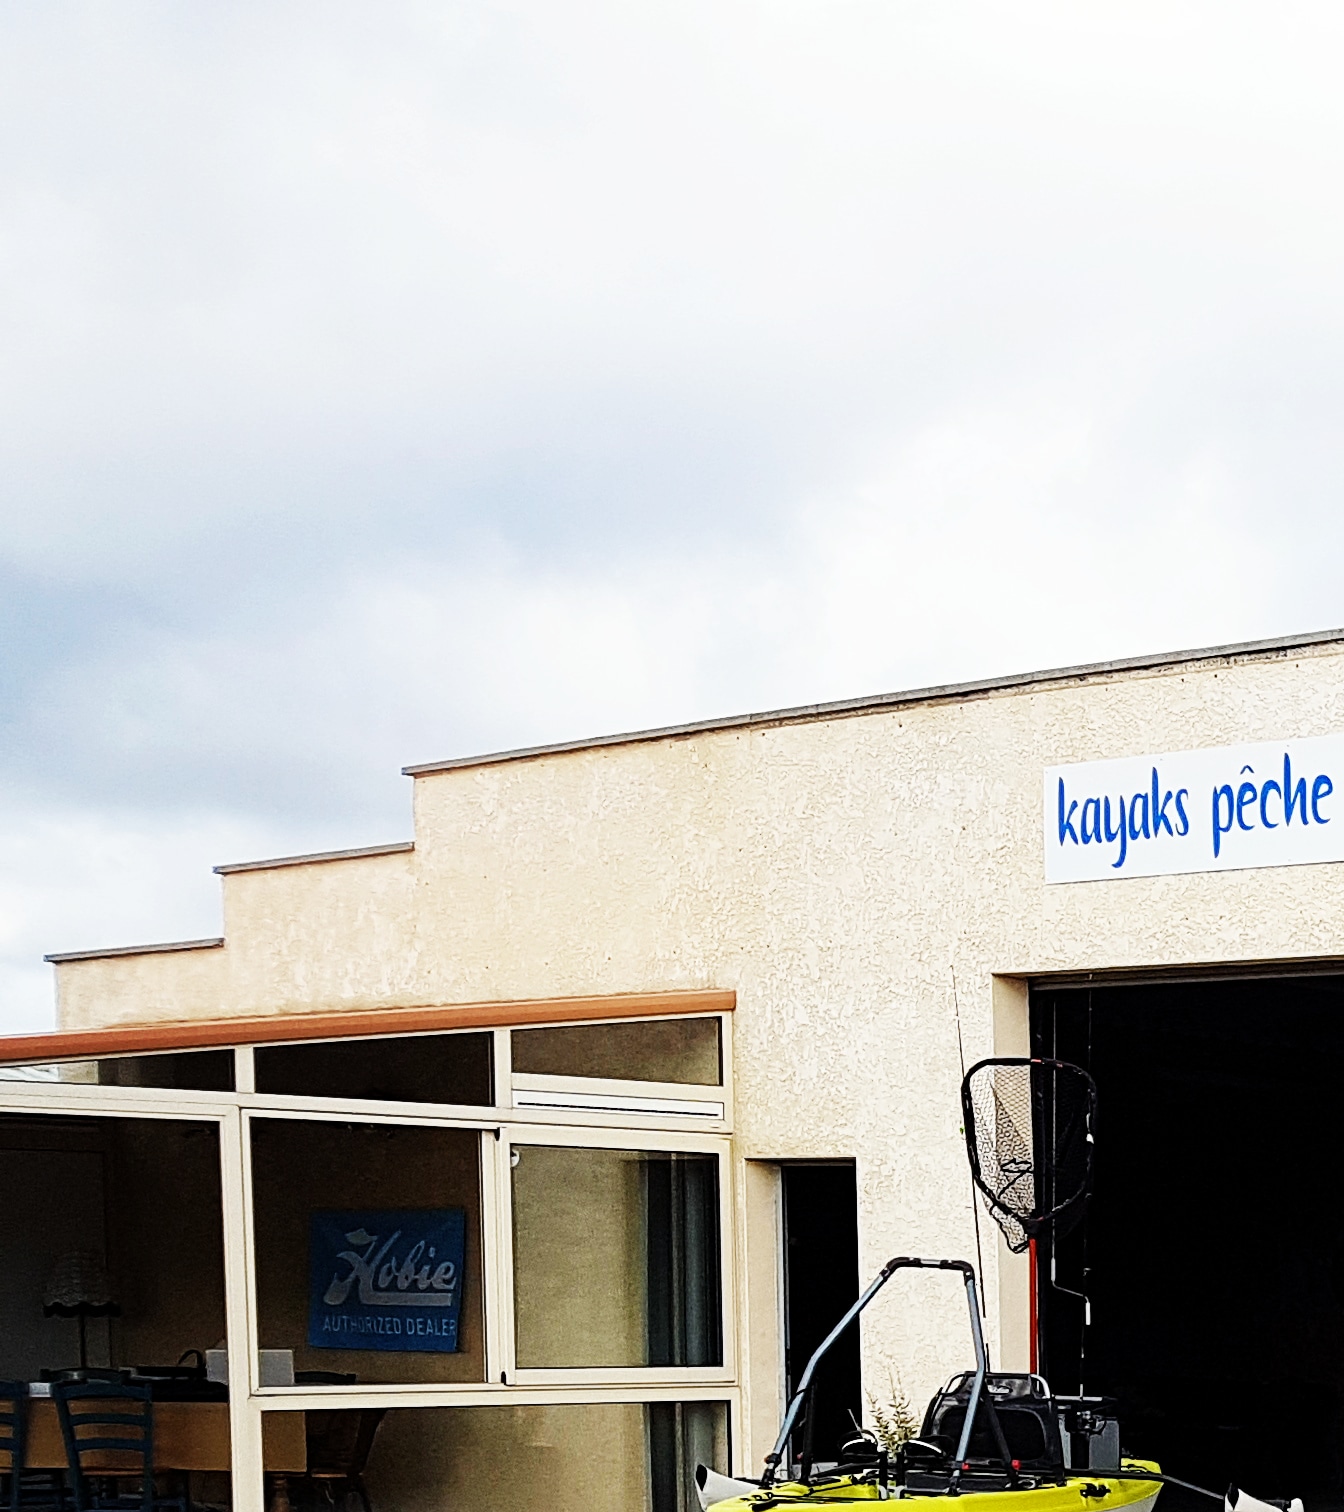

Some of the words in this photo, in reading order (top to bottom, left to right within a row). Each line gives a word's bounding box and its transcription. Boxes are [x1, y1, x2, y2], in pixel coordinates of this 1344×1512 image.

[1058, 767, 1190, 869] kayaks
[1212, 752, 1334, 858] pêche
[323, 1228, 457, 1306] Hobie
[322, 1315, 402, 1336] AUTHORIZED
[406, 1317, 456, 1336] DEALER
